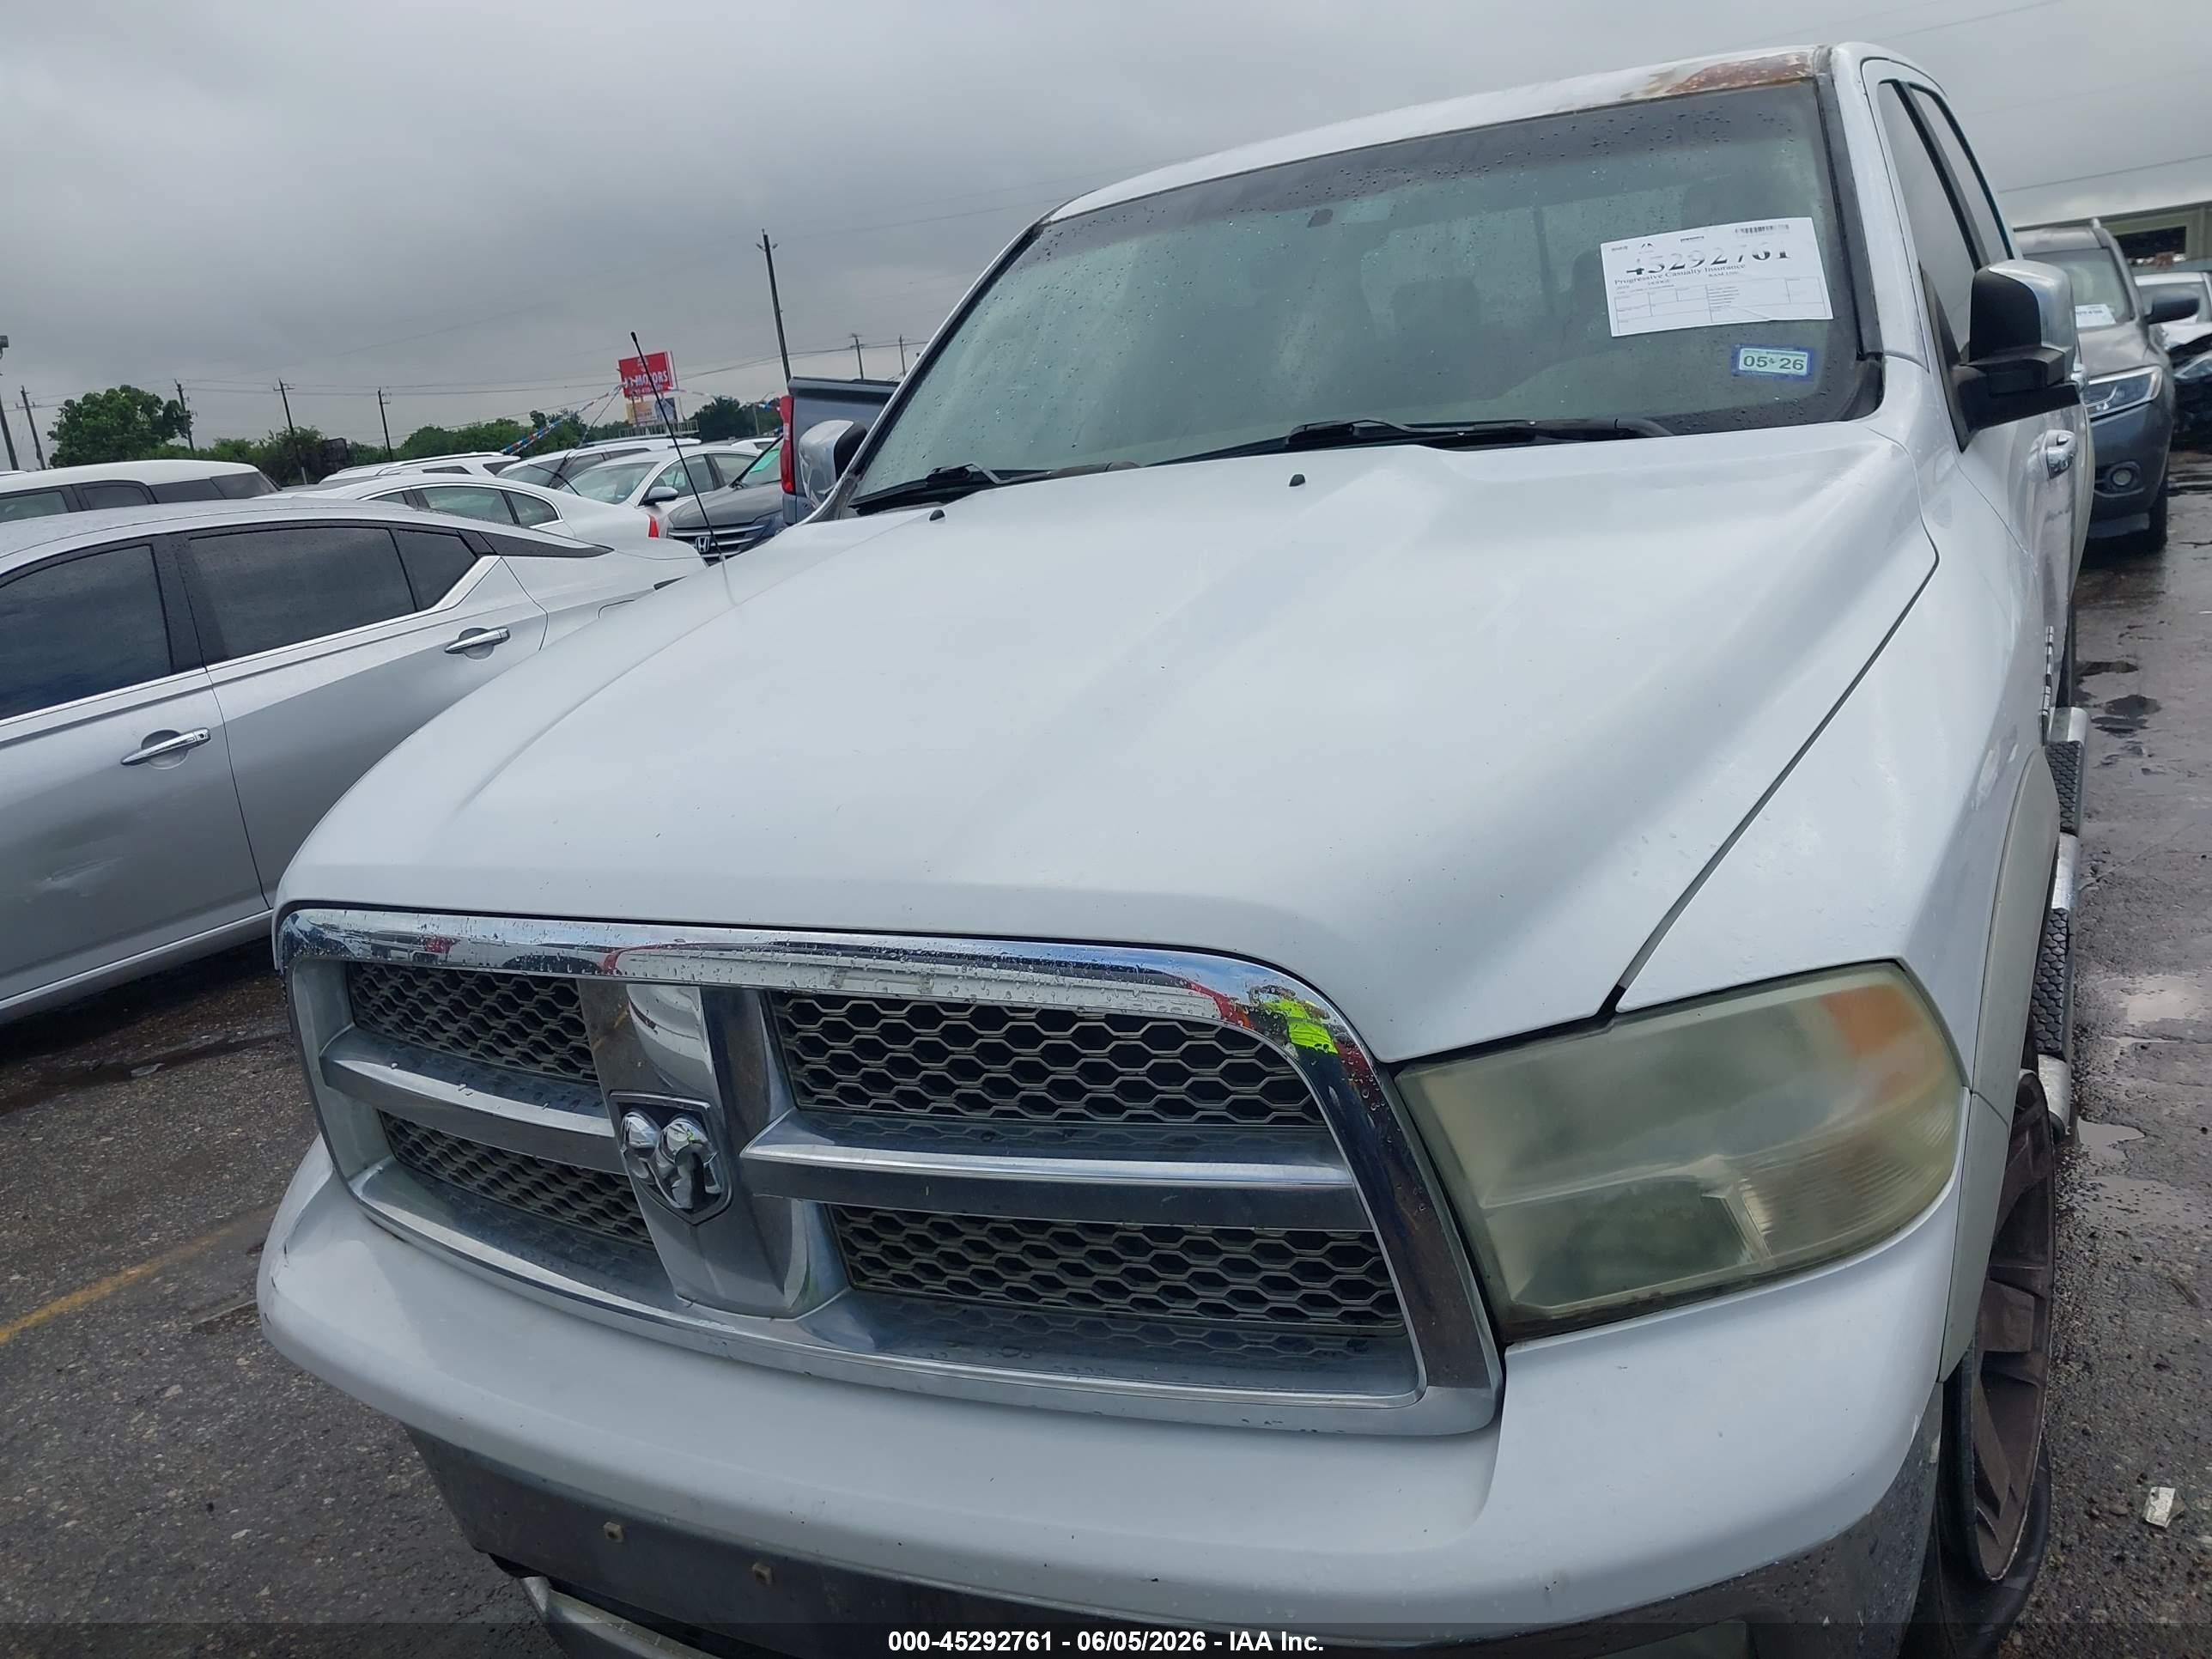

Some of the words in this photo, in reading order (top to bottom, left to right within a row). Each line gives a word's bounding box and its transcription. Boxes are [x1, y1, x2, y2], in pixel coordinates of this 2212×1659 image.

[1613, 273, 1663, 286] Progressive
[1665, 267, 1702, 279] Casualty
[1705, 264, 1746, 273] Insurance
[1743, 356, 1768, 368] 05
[1778, 357, 1805, 371] 26
